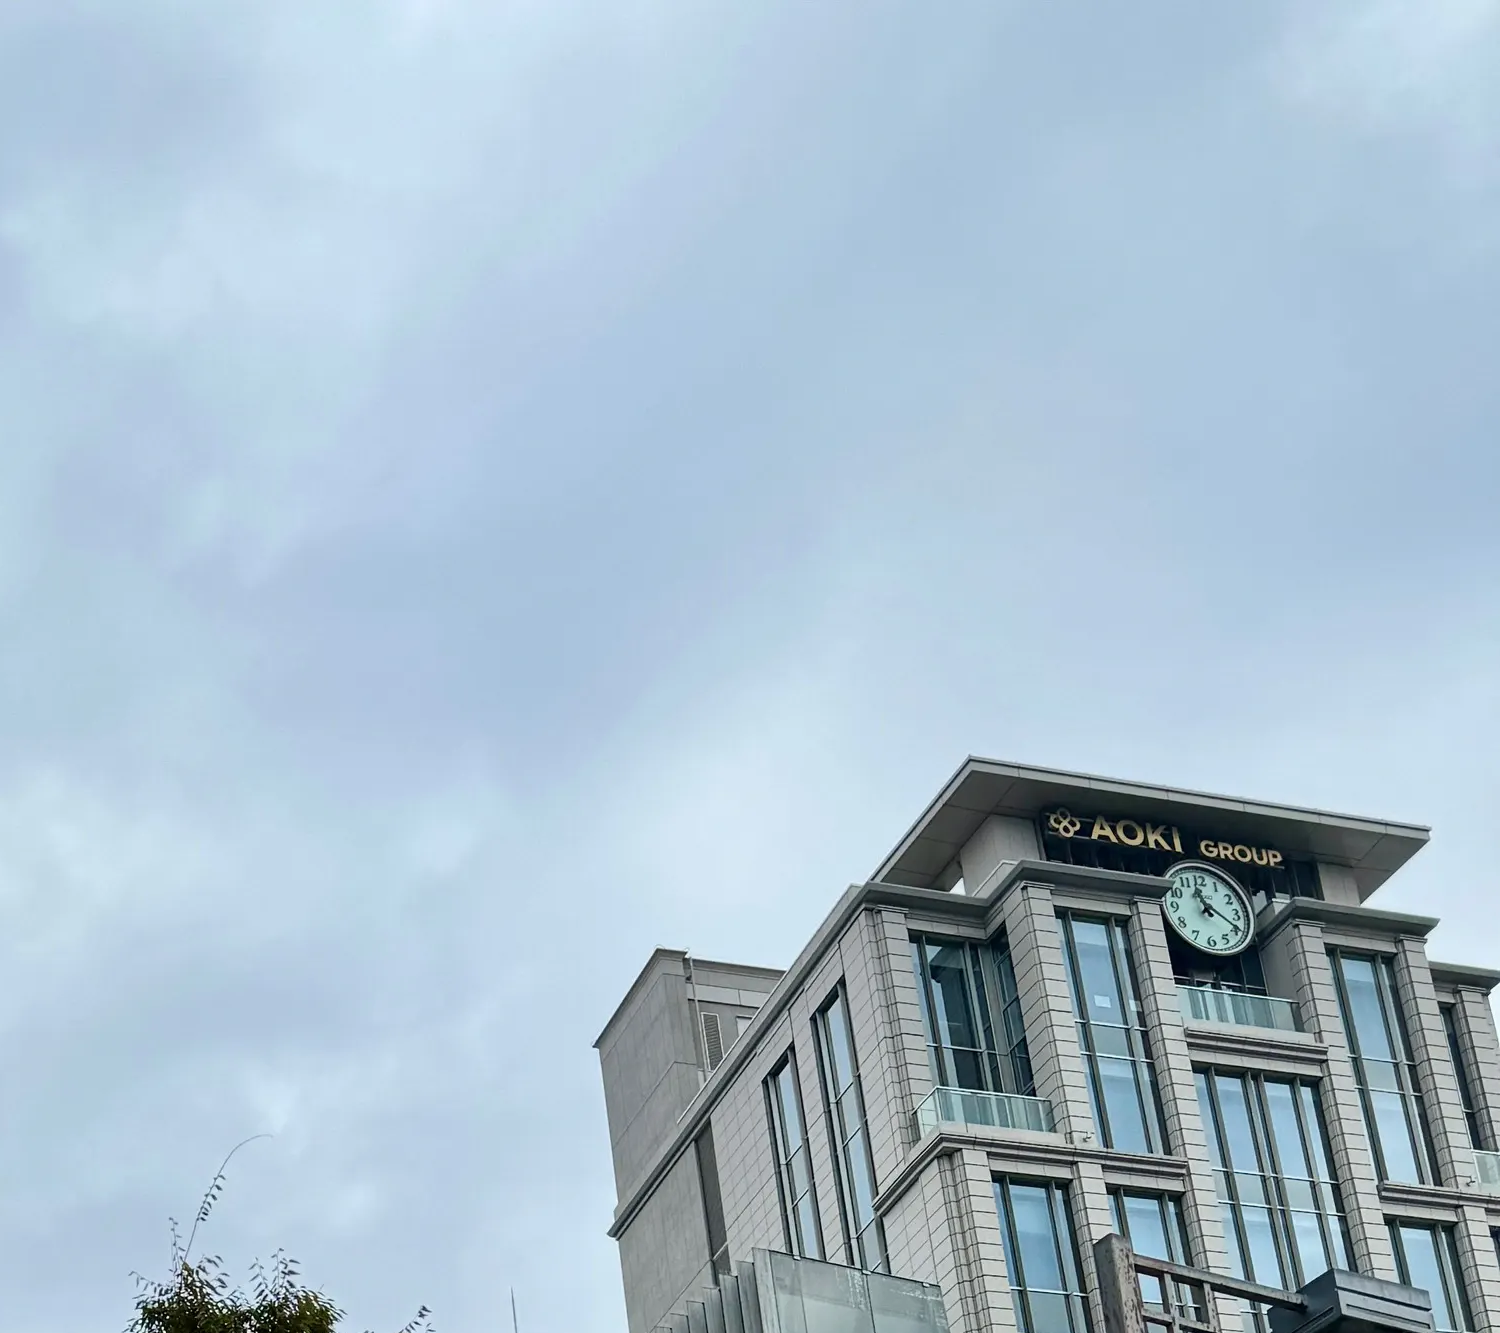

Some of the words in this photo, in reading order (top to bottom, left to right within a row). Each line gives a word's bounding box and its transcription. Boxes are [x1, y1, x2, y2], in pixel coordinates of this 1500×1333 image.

[1091, 815, 1185, 853] AOKI
[1200, 840, 1283, 867] GROUP
[1179, 877, 1191, 888] 11
[1212, 882, 1219, 892] 1
[1223, 894, 1234, 906] 2
[1170, 901, 1179, 913] 9
[1231, 908, 1241, 921] 3
[1177, 916, 1187, 928] 8
[1191, 929, 1200, 941] 7
[1206, 935, 1217, 947] 6
[1221, 933, 1230, 945] 5
